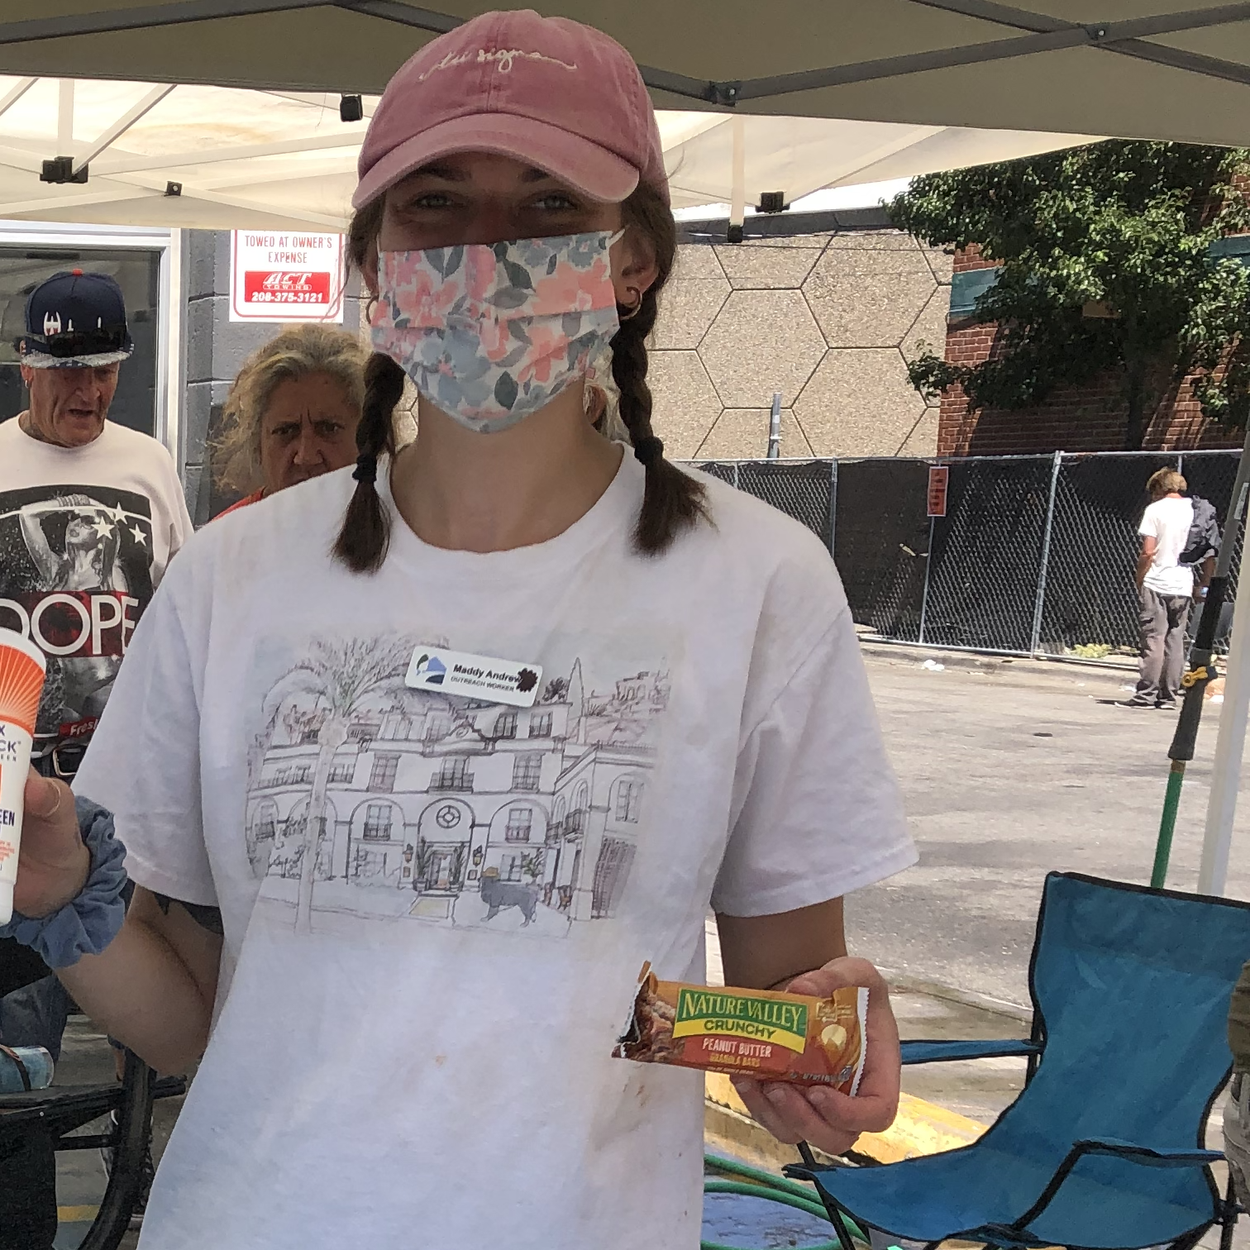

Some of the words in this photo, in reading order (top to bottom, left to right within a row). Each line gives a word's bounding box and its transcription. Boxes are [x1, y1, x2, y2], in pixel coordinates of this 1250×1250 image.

[245, 235, 275, 247] TOWED
[279, 236, 289, 248] AT
[293, 237, 333, 248] OWNER'S
[268, 251, 307, 263] EXPENSE
[262, 272, 312, 285] ACT
[251, 292, 323, 303] 208-375-3121
[453, 664, 484, 679] Maddy
[486, 671, 523, 683] Andrew
[682, 991, 744, 1019] NATURE
[747, 1000, 803, 1031] VALLEY
[703, 1019, 777, 1040] CRUNCHY
[702, 1037, 737, 1053] PEANUT
[738, 1042, 772, 1058] BUTTER
